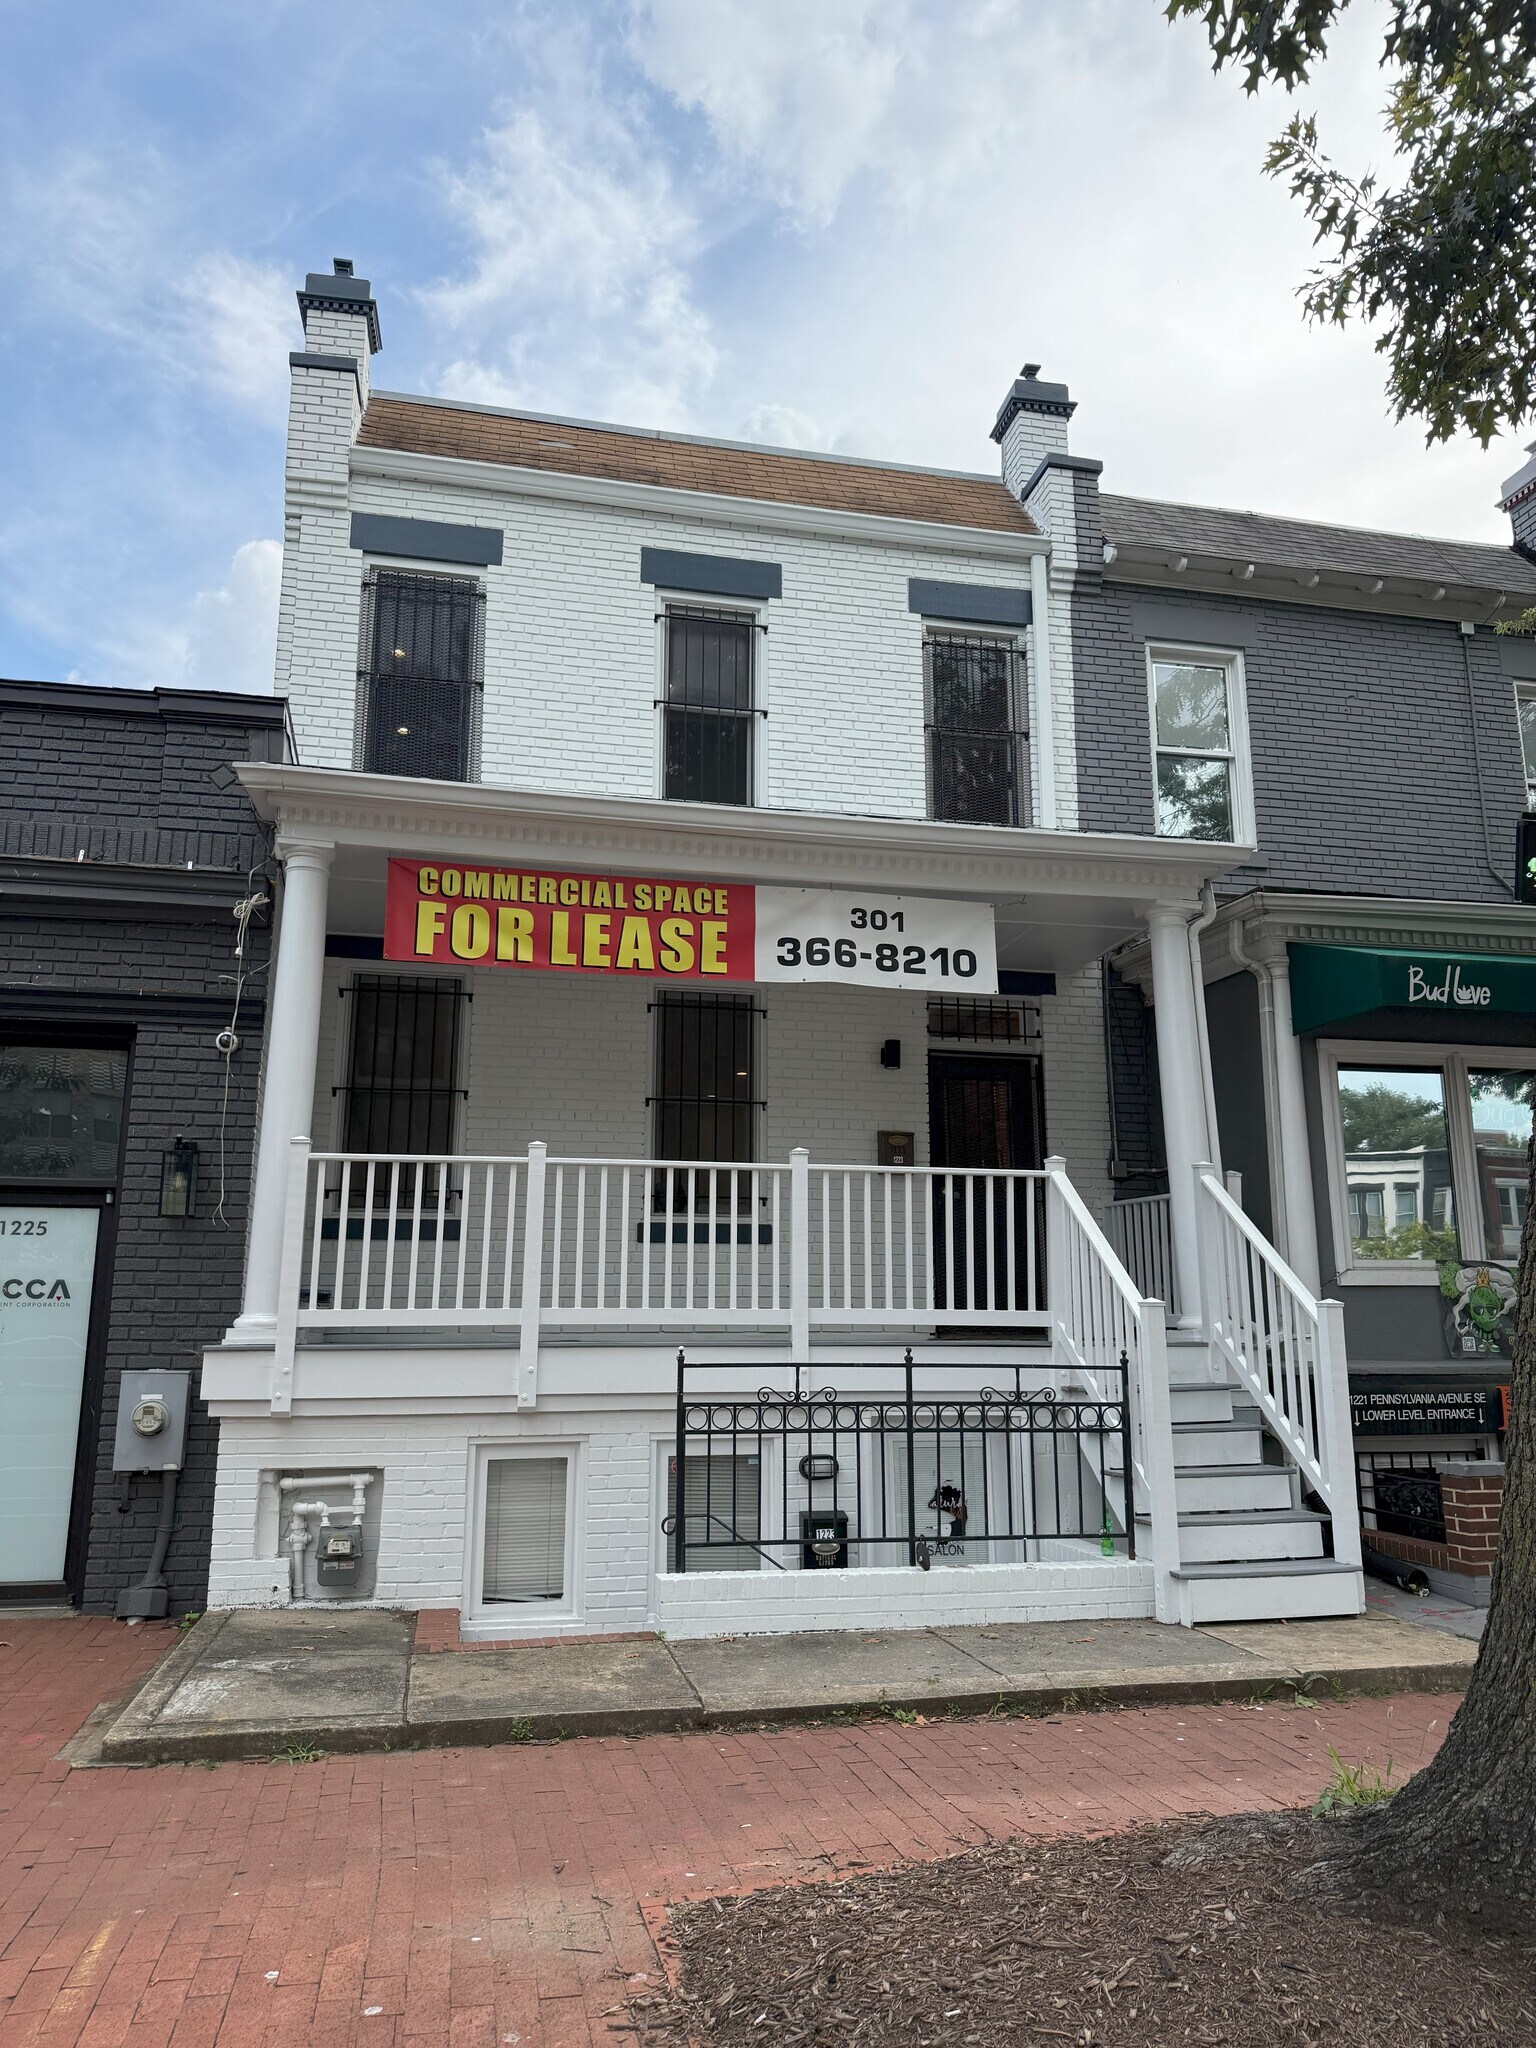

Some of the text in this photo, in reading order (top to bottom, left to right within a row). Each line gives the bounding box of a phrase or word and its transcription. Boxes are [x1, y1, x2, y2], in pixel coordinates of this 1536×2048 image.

[418, 867, 729, 916] COMMERCIAL SPACE
[850, 908, 905, 933] 301
[415, 901, 729, 974] FOR LEASE
[776, 937, 978, 978] 366-8210
[0, 1220, 47, 1236] 1225
[1350, 1392, 1487, 1405] 1221 PENNSYLVANIA AVENUE SE
[1362, 1408, 1476, 1421] LOWER LEVEL ENTRANCE
[816, 1529, 835, 1540] 1223
[927, 1545, 965, 1556] SALON
